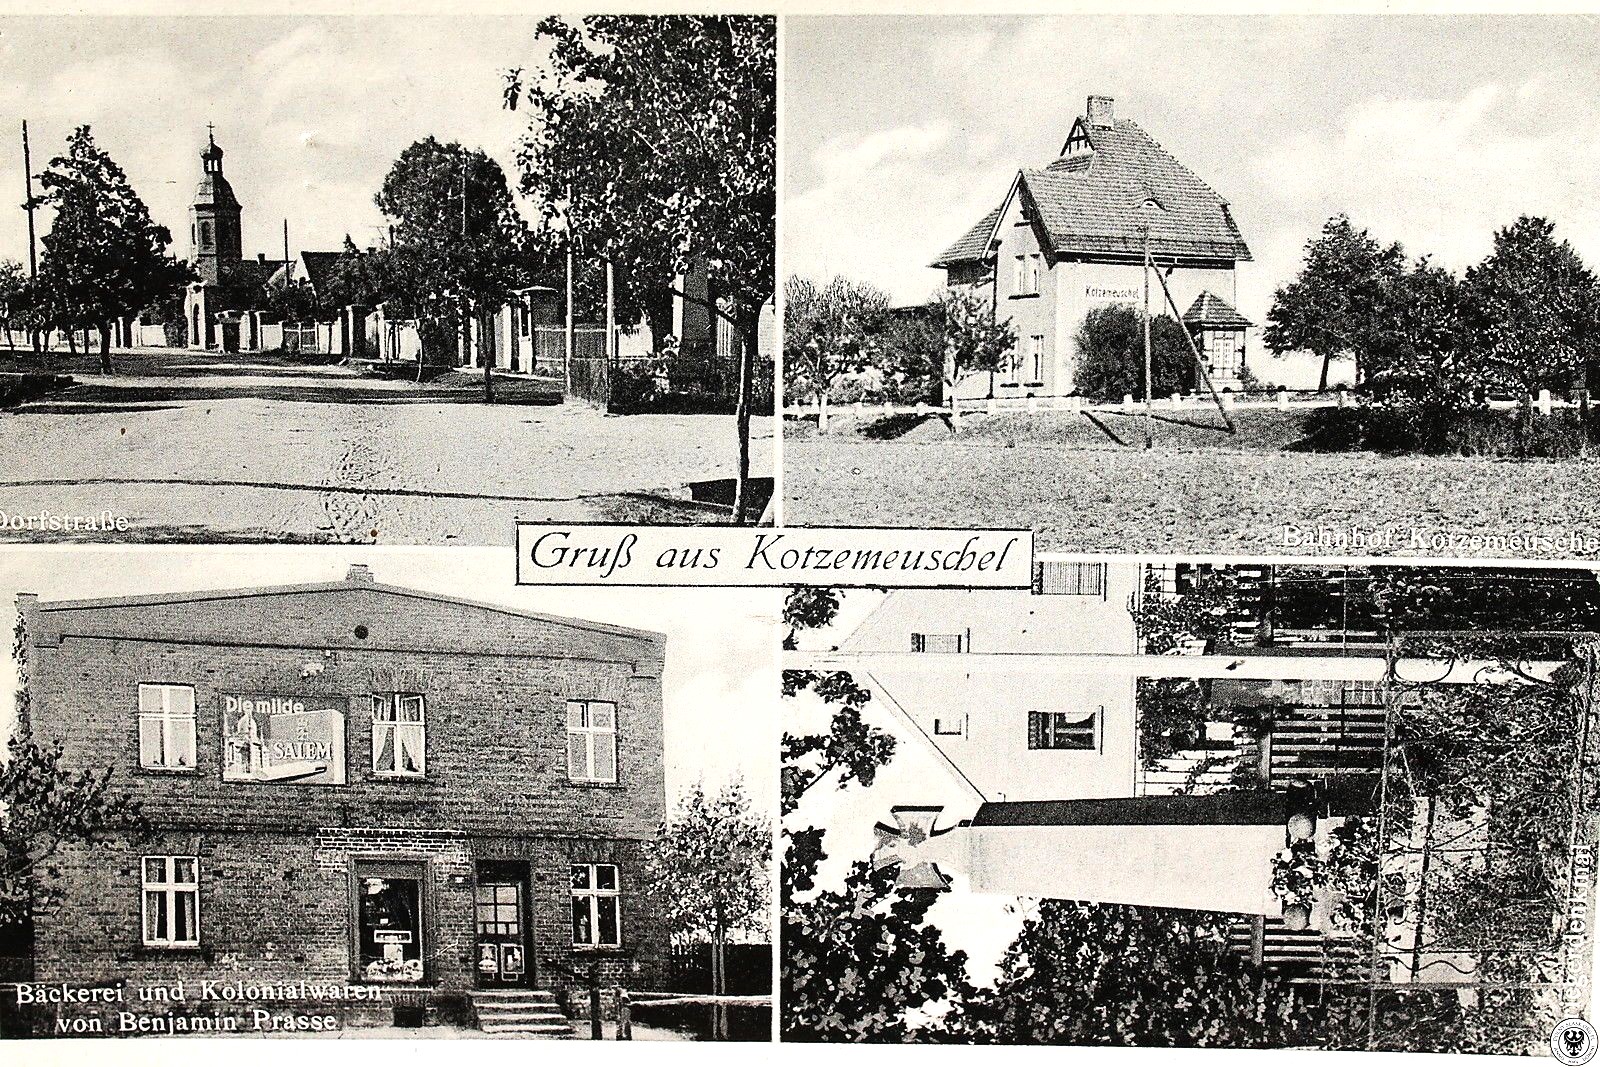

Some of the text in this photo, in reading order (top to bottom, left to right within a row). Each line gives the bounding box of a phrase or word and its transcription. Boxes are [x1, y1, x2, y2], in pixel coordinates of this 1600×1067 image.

[1085, 285, 1140, 299] Kotzemeuschel
[1281, 524, 1600, 552] Bahnhof Kotzemeusche
[530, 530, 1017, 578] Gruß aus Kotzemeuschel
[225, 697, 305, 714] Die milde
[273, 742, 333, 760] SALEM
[1562, 843, 1591, 1018] riegerdenkmal
[16, 979, 382, 1005] Bäckerei und Kolonialwaren
[57, 1010, 337, 1035] von Benjamin Prasse
